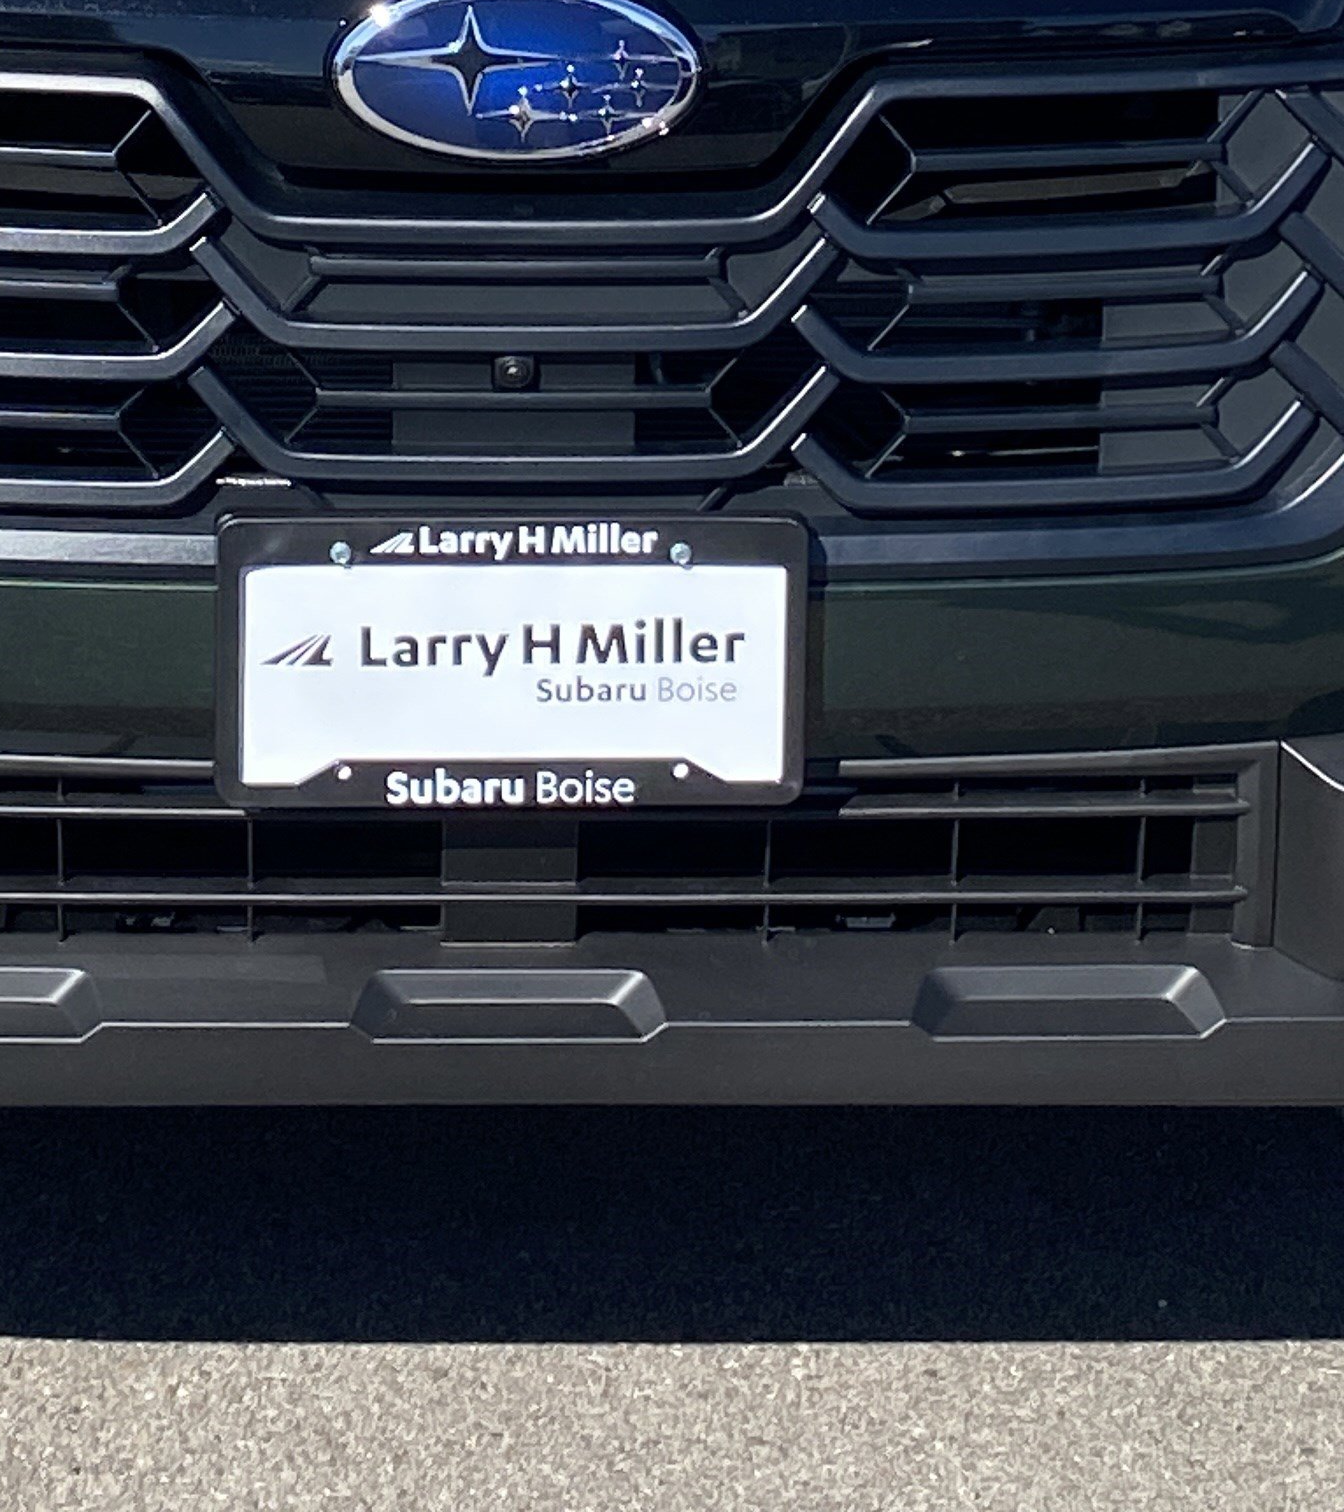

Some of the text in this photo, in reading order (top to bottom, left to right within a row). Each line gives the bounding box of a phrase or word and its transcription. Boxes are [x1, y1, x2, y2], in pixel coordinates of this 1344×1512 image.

[418, 523, 658, 561] Larry H Miller
[360, 617, 746, 677] Larry H Miller
[536, 676, 738, 703] Subaru Boise
[385, 767, 635, 805] Subaru Boise
